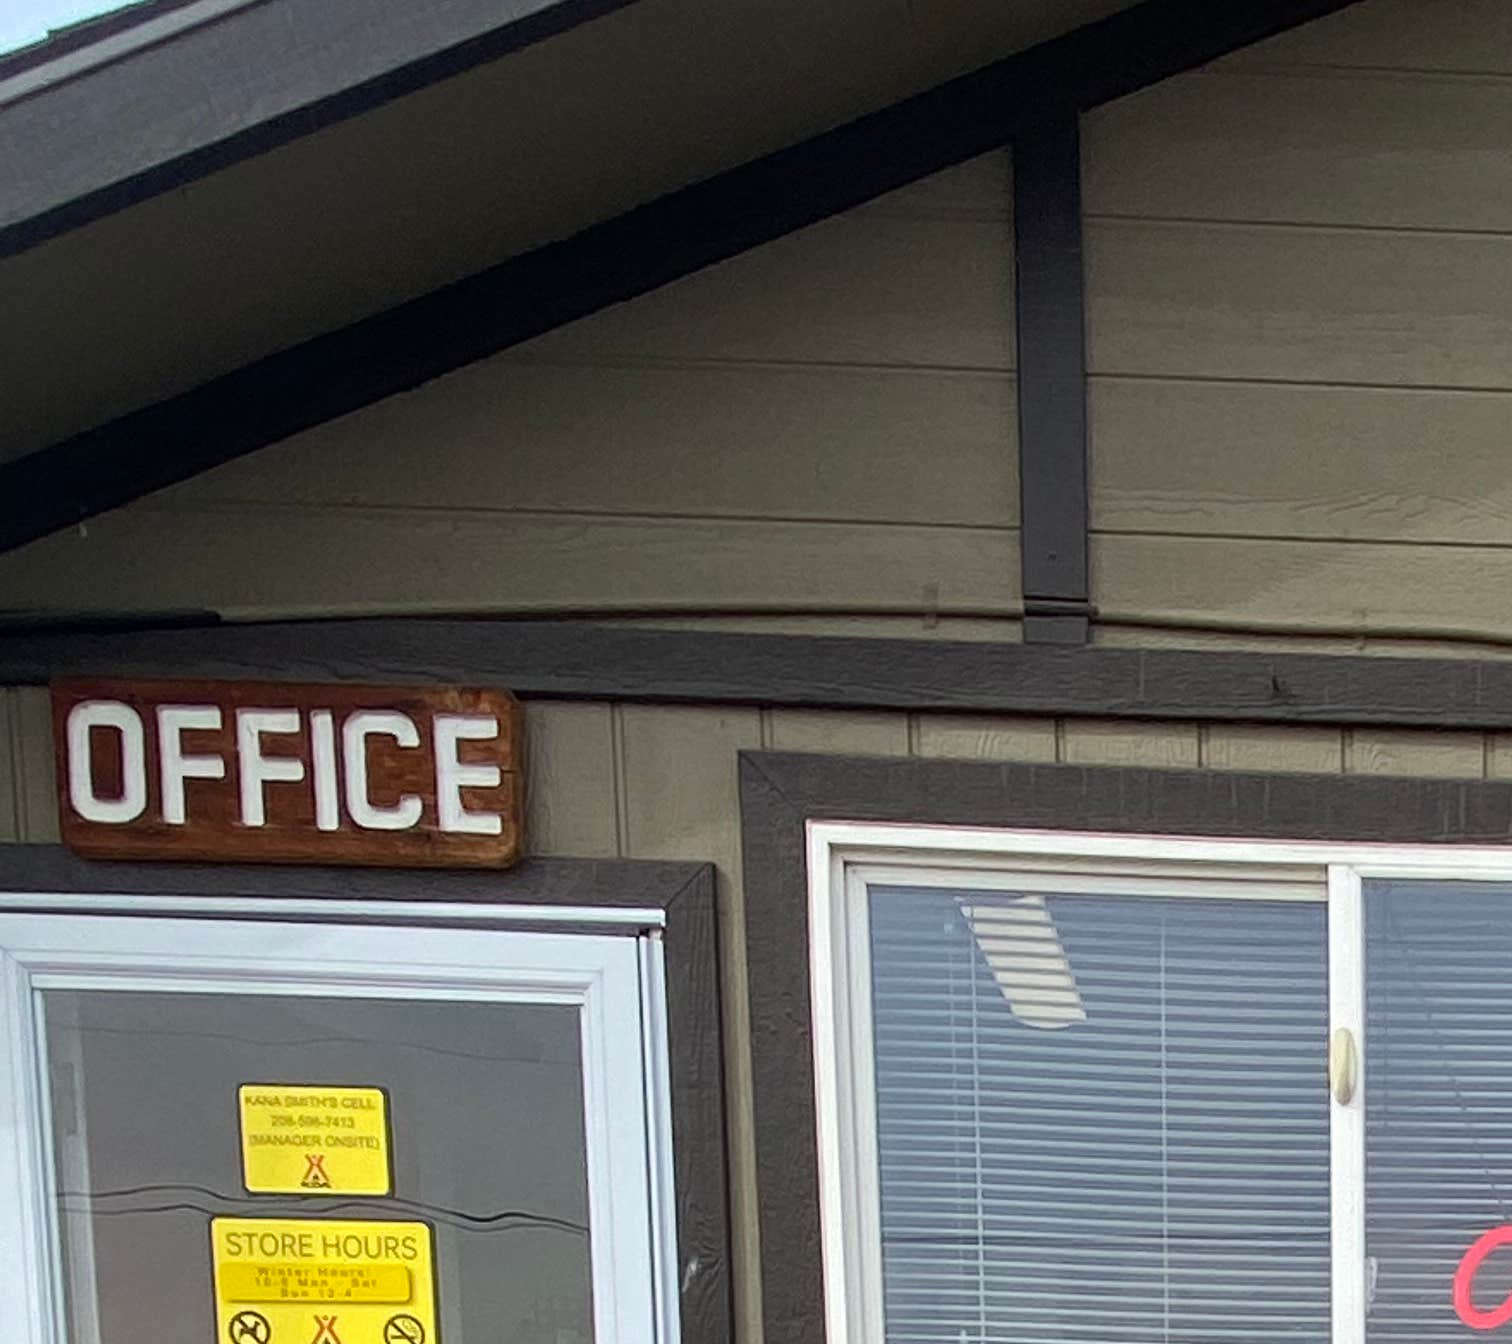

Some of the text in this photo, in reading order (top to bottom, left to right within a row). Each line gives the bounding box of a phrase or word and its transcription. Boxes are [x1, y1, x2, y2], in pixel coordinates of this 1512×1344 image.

[67, 699, 502, 834] OFFICE
[341, 1097, 377, 1110] CELL
[225, 1232, 418, 1261] STORE HOURS
